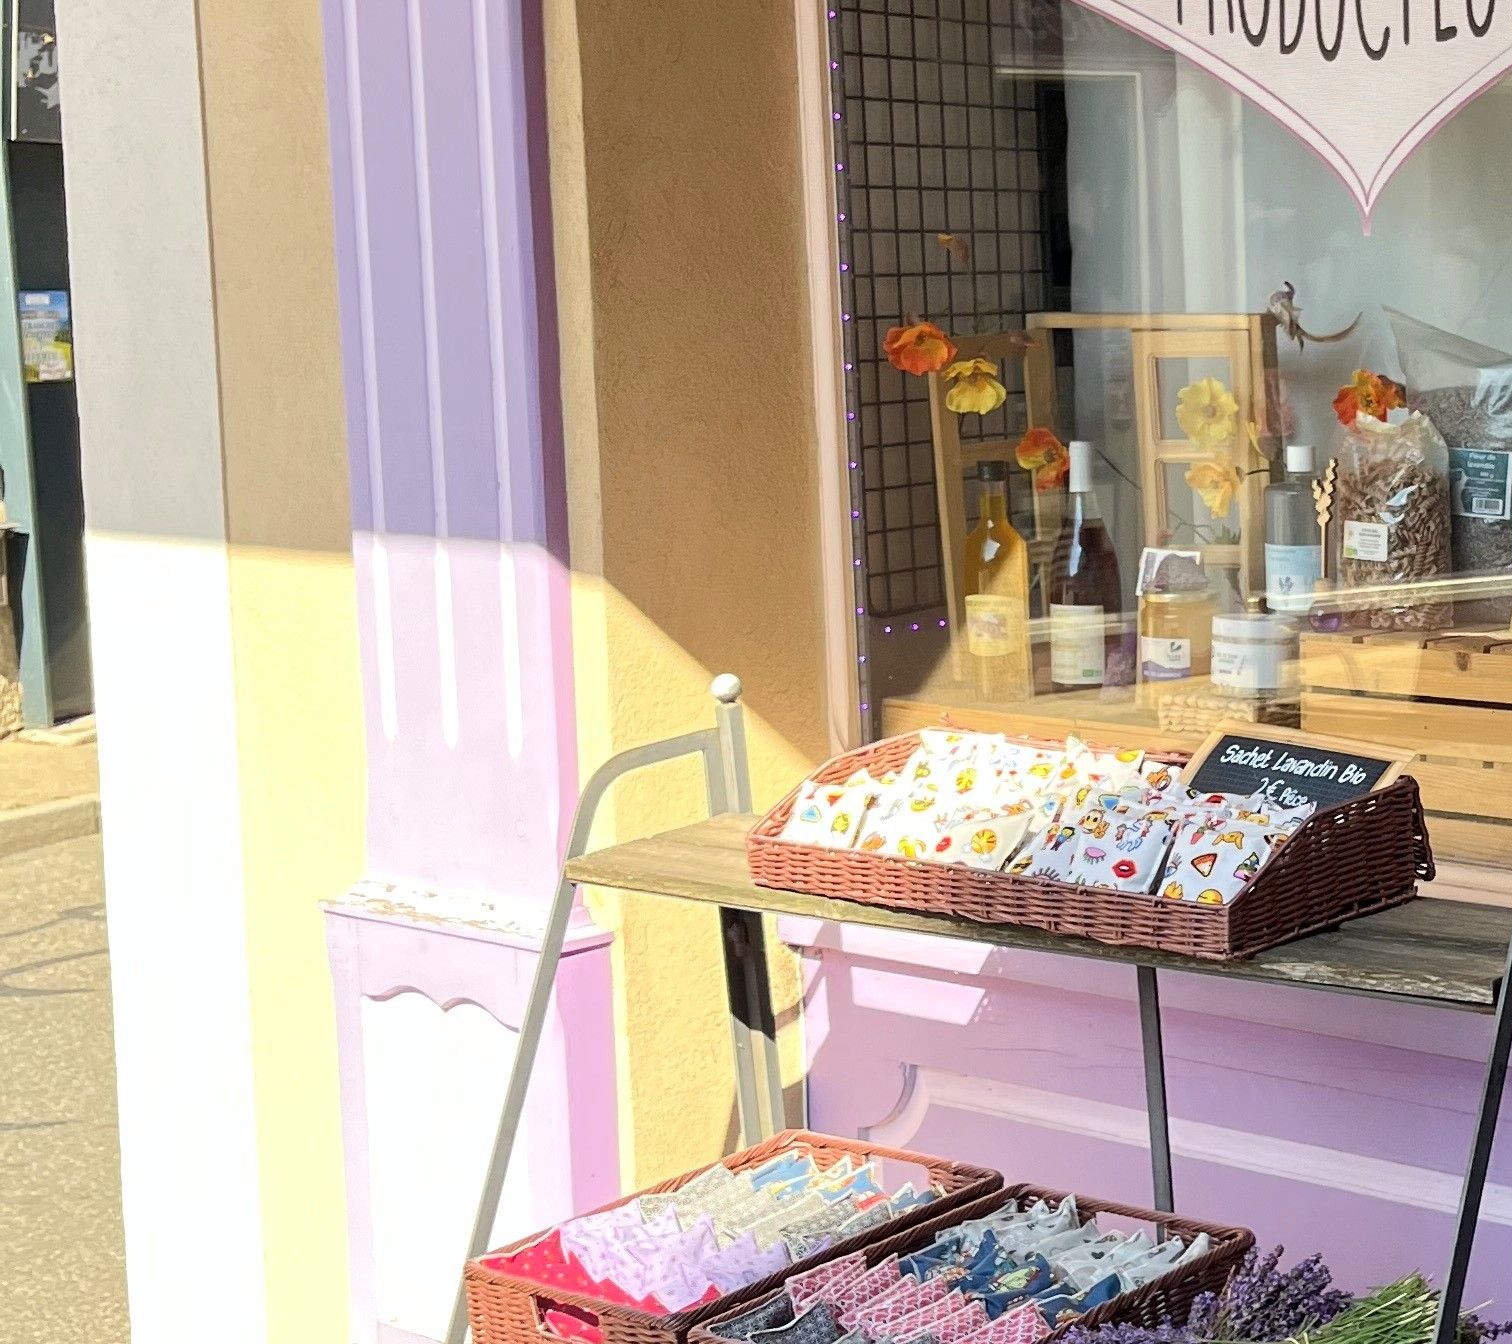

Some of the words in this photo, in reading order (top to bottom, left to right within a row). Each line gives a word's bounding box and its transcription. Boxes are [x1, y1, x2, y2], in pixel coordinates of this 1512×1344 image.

[1219, 744, 1275, 770] Sachet
[1271, 751, 1339, 780] Lavandin
[1337, 763, 1367, 786] Bio
